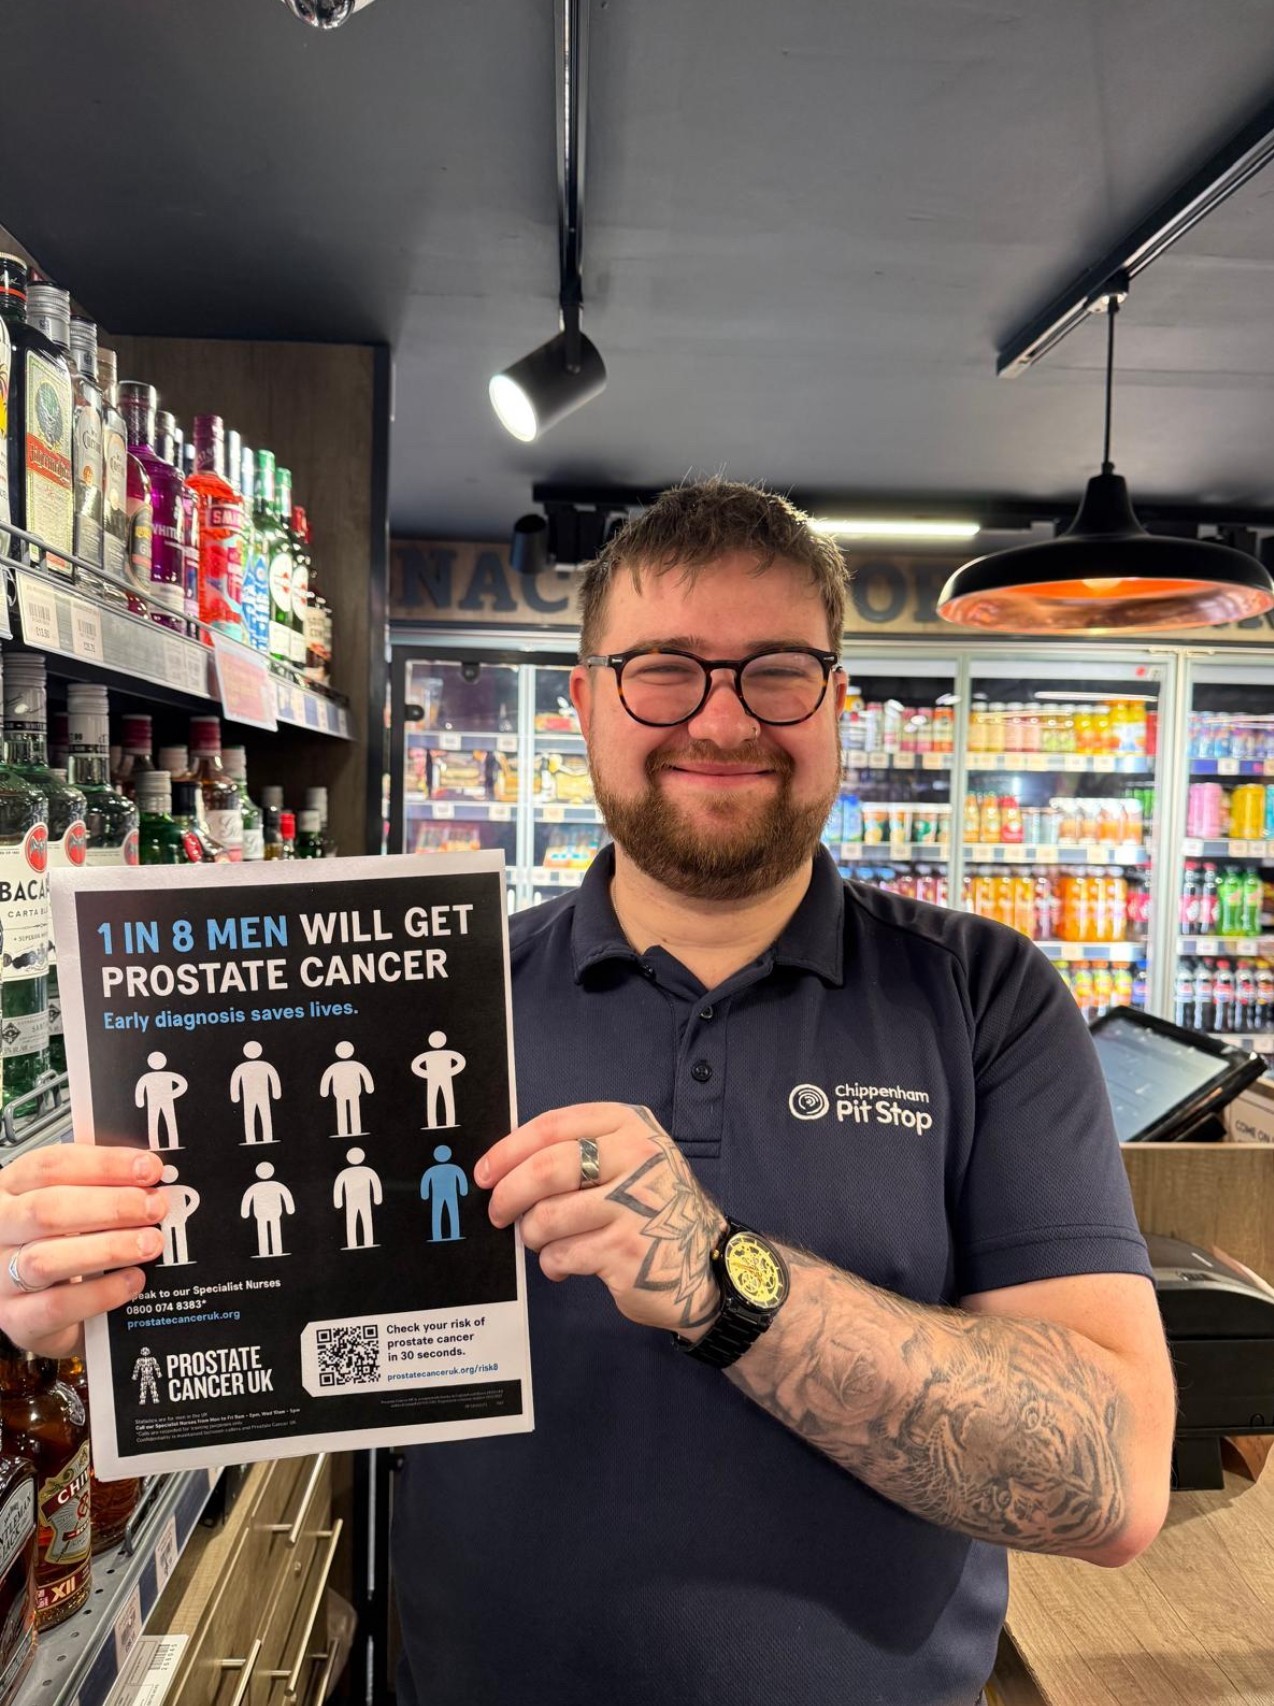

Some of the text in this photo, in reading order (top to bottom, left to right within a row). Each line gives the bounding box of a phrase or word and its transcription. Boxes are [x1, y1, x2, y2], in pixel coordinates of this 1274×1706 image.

[98, 904, 474, 955] 1 IN 8 MEN WILL GET
[101, 949, 449, 998] PROSTATE CANCER
[103, 1001, 359, 1034] Early diagnosis saves lives.
[835, 1082, 930, 1103] Chippenham
[837, 1099, 933, 1136] Pit Stop
[131, 1279, 282, 1302] peak to our Specialist Nurses
[126, 1305, 153, 1315] 0800
[155, 1302, 174, 1313] 074
[127, 1310, 241, 1331] prostatecanceruk.org
[386, 1316, 486, 1334] Check your risk of
[387, 1333, 474, 1350] prostate cancer
[166, 1345, 262, 1378] PROSTATE
[388, 1347, 466, 1362] in 30 seconds.
[387, 1363, 498, 1381] prostatecanceruk.org/risk8
[168, 1368, 274, 1402] CANCER UK
